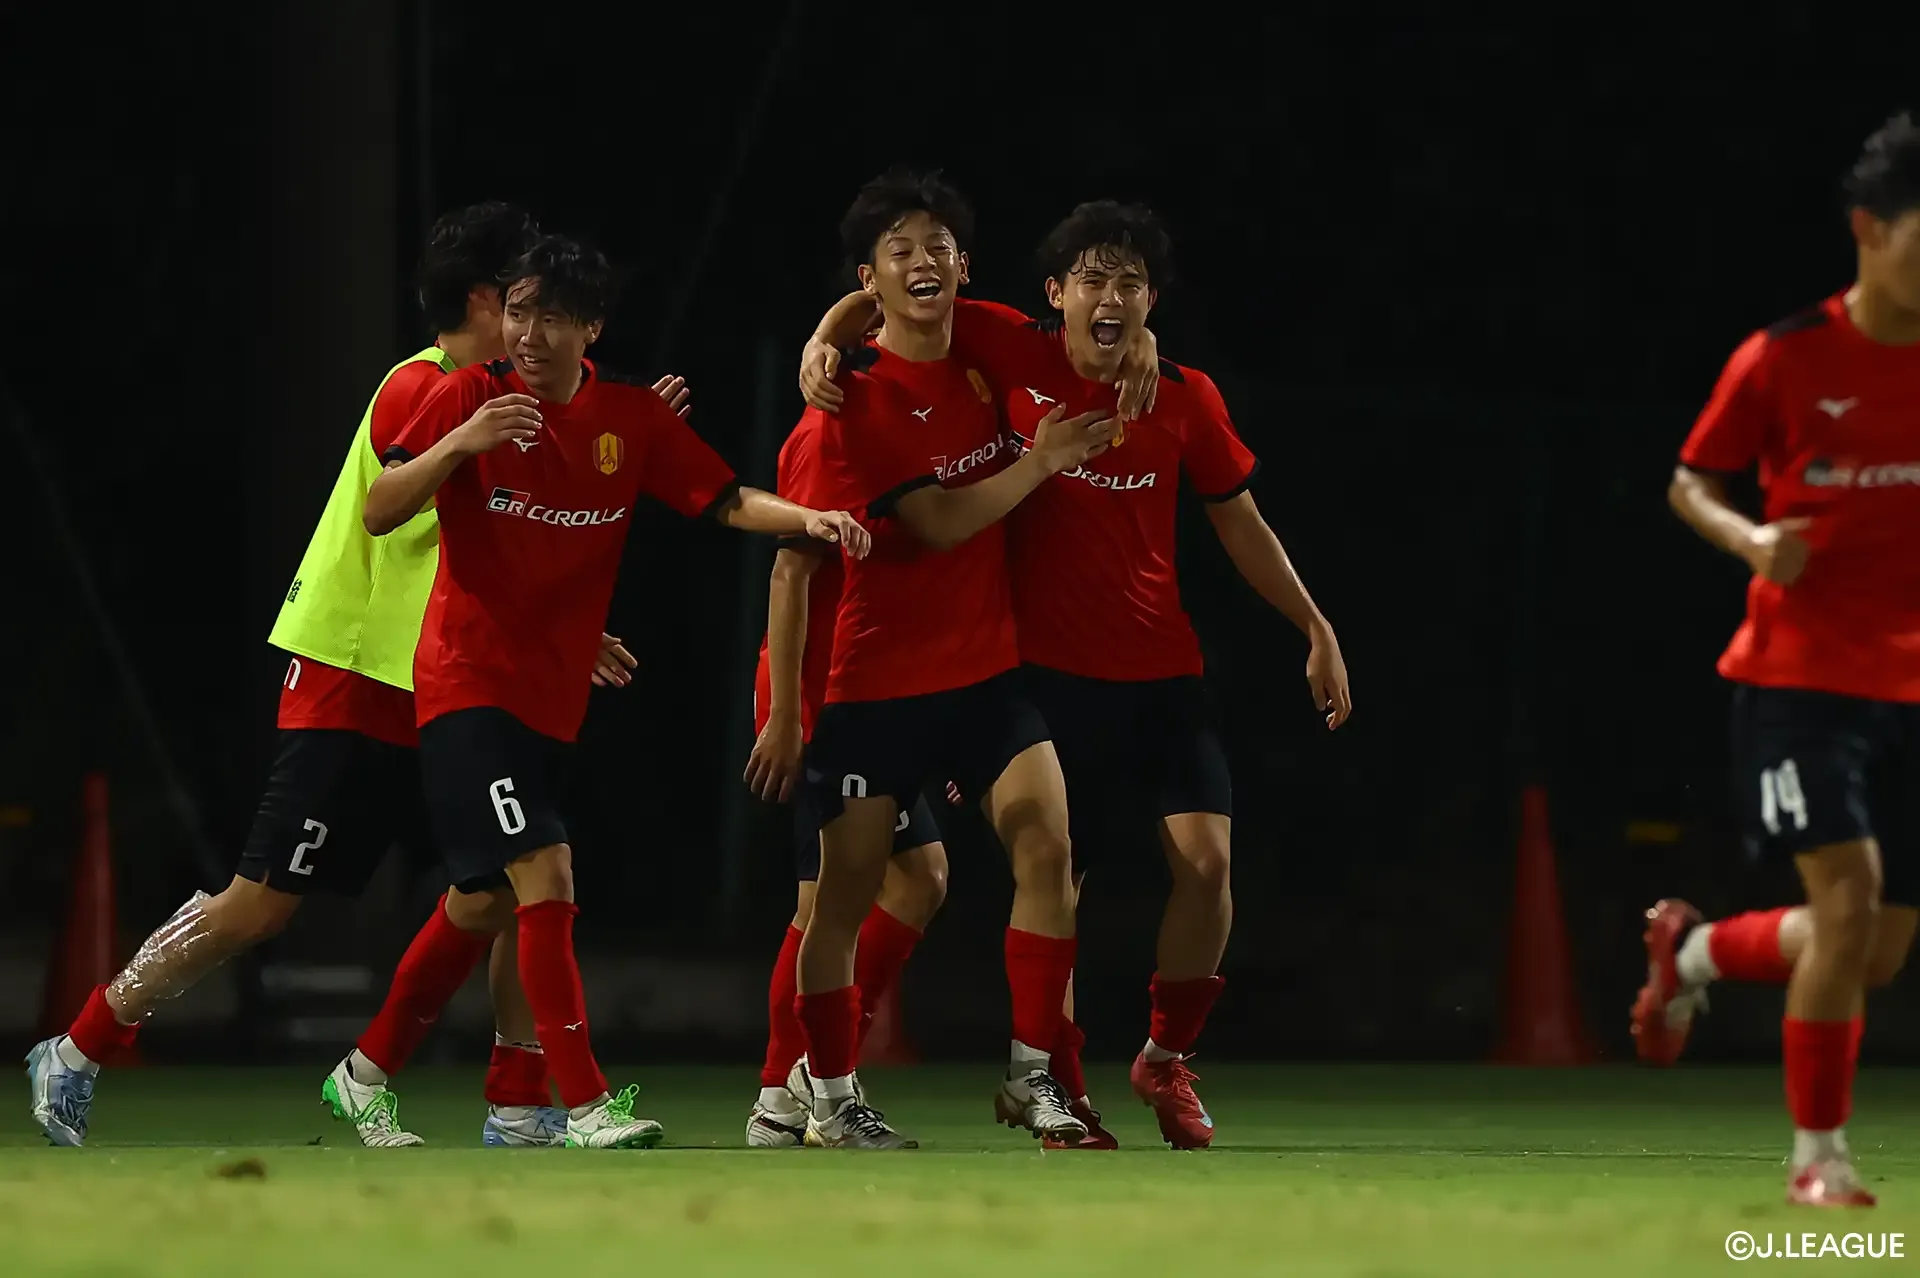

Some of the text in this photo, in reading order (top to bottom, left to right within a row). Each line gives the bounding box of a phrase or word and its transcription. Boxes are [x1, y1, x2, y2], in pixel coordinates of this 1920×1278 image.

[488, 496, 525, 515] GR
[489, 777, 526, 835] 6
[1760, 759, 1808, 835] 14
[288, 818, 328, 875] 2
